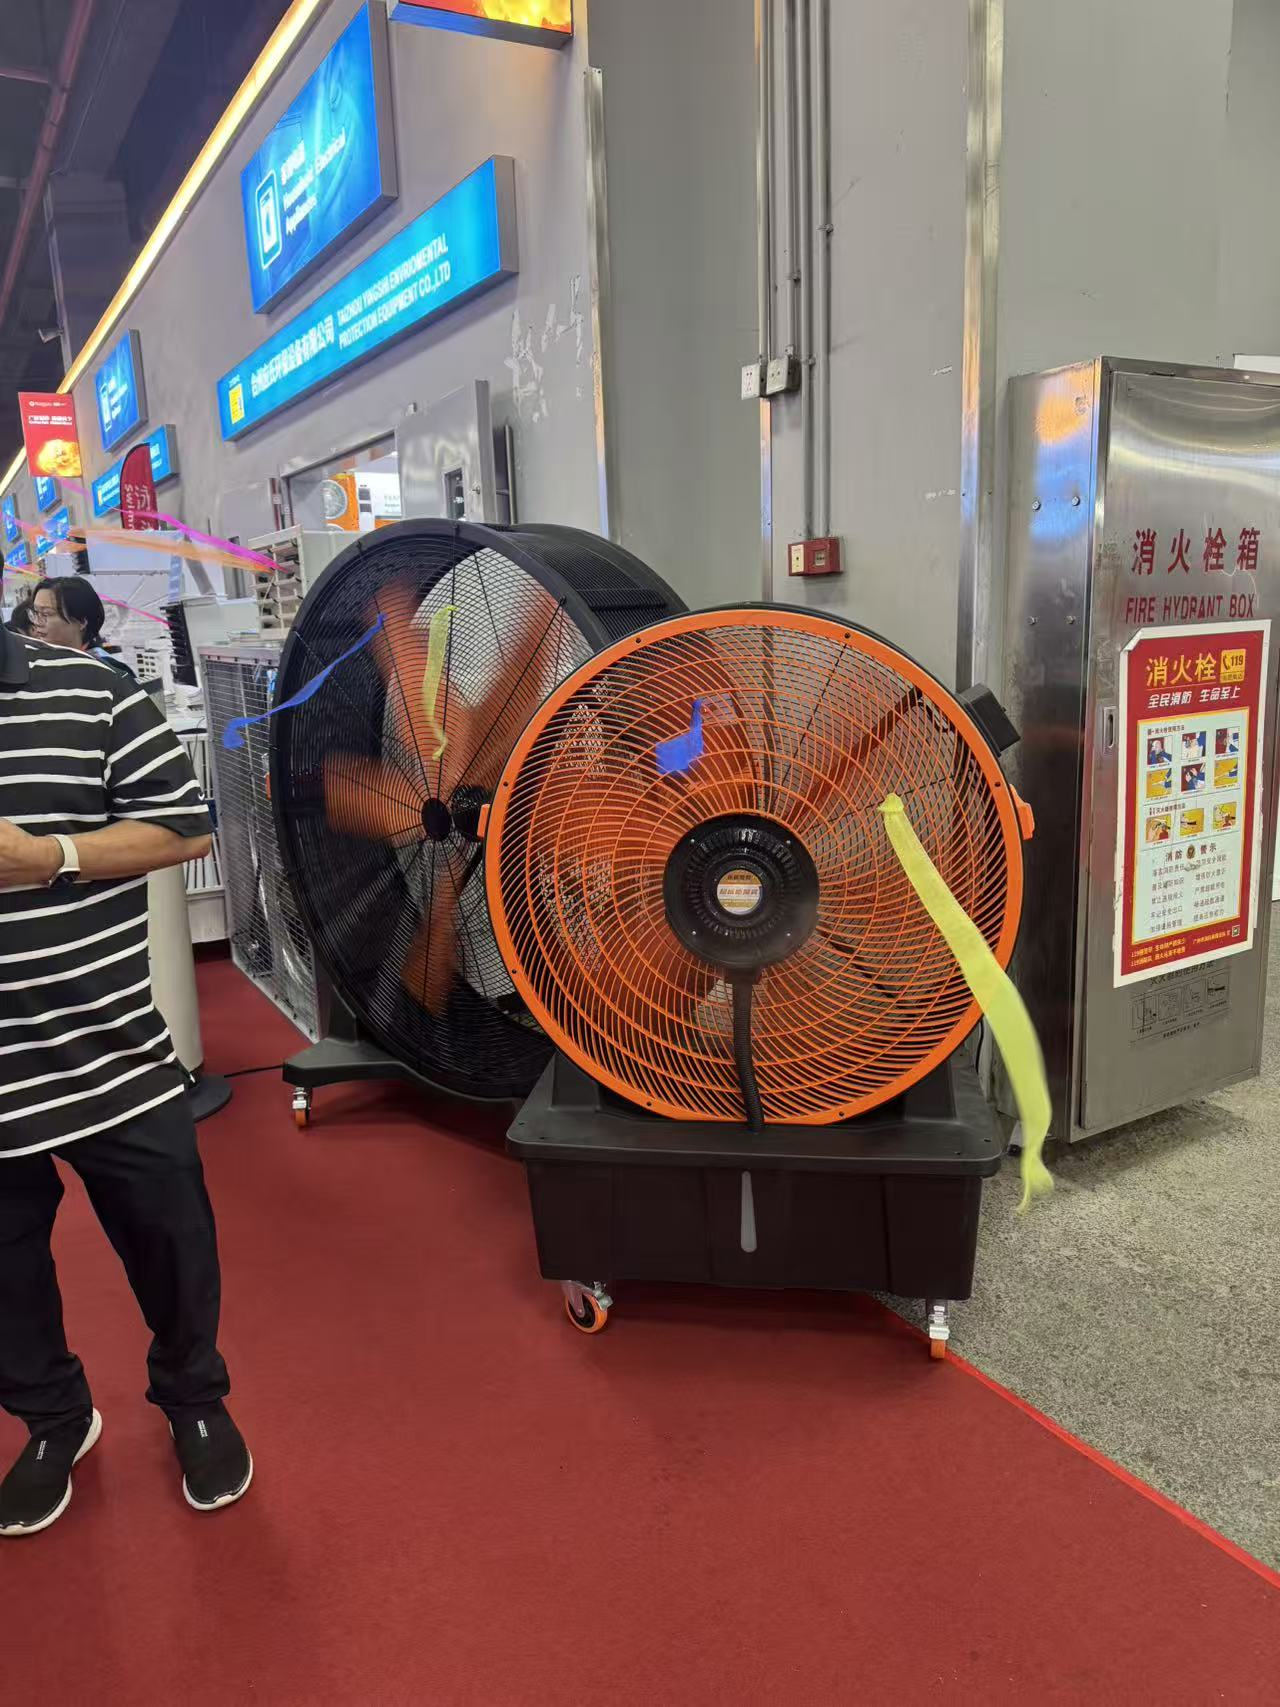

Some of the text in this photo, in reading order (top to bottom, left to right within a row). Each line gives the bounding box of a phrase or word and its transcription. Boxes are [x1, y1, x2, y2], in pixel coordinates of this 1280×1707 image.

[339, 310, 378, 350] PROTECTION
[377, 282, 418, 325] EQUIPMENT
[1131, 526, 1261, 575] 消火栓箱
[1125, 593, 1255, 625] FIRE HYDRANT BOX
[1145, 652, 1217, 687] 消火栓
[1230, 655, 1244, 667] 119
[1148, 685, 1241, 709] 全民消防 生命至上
